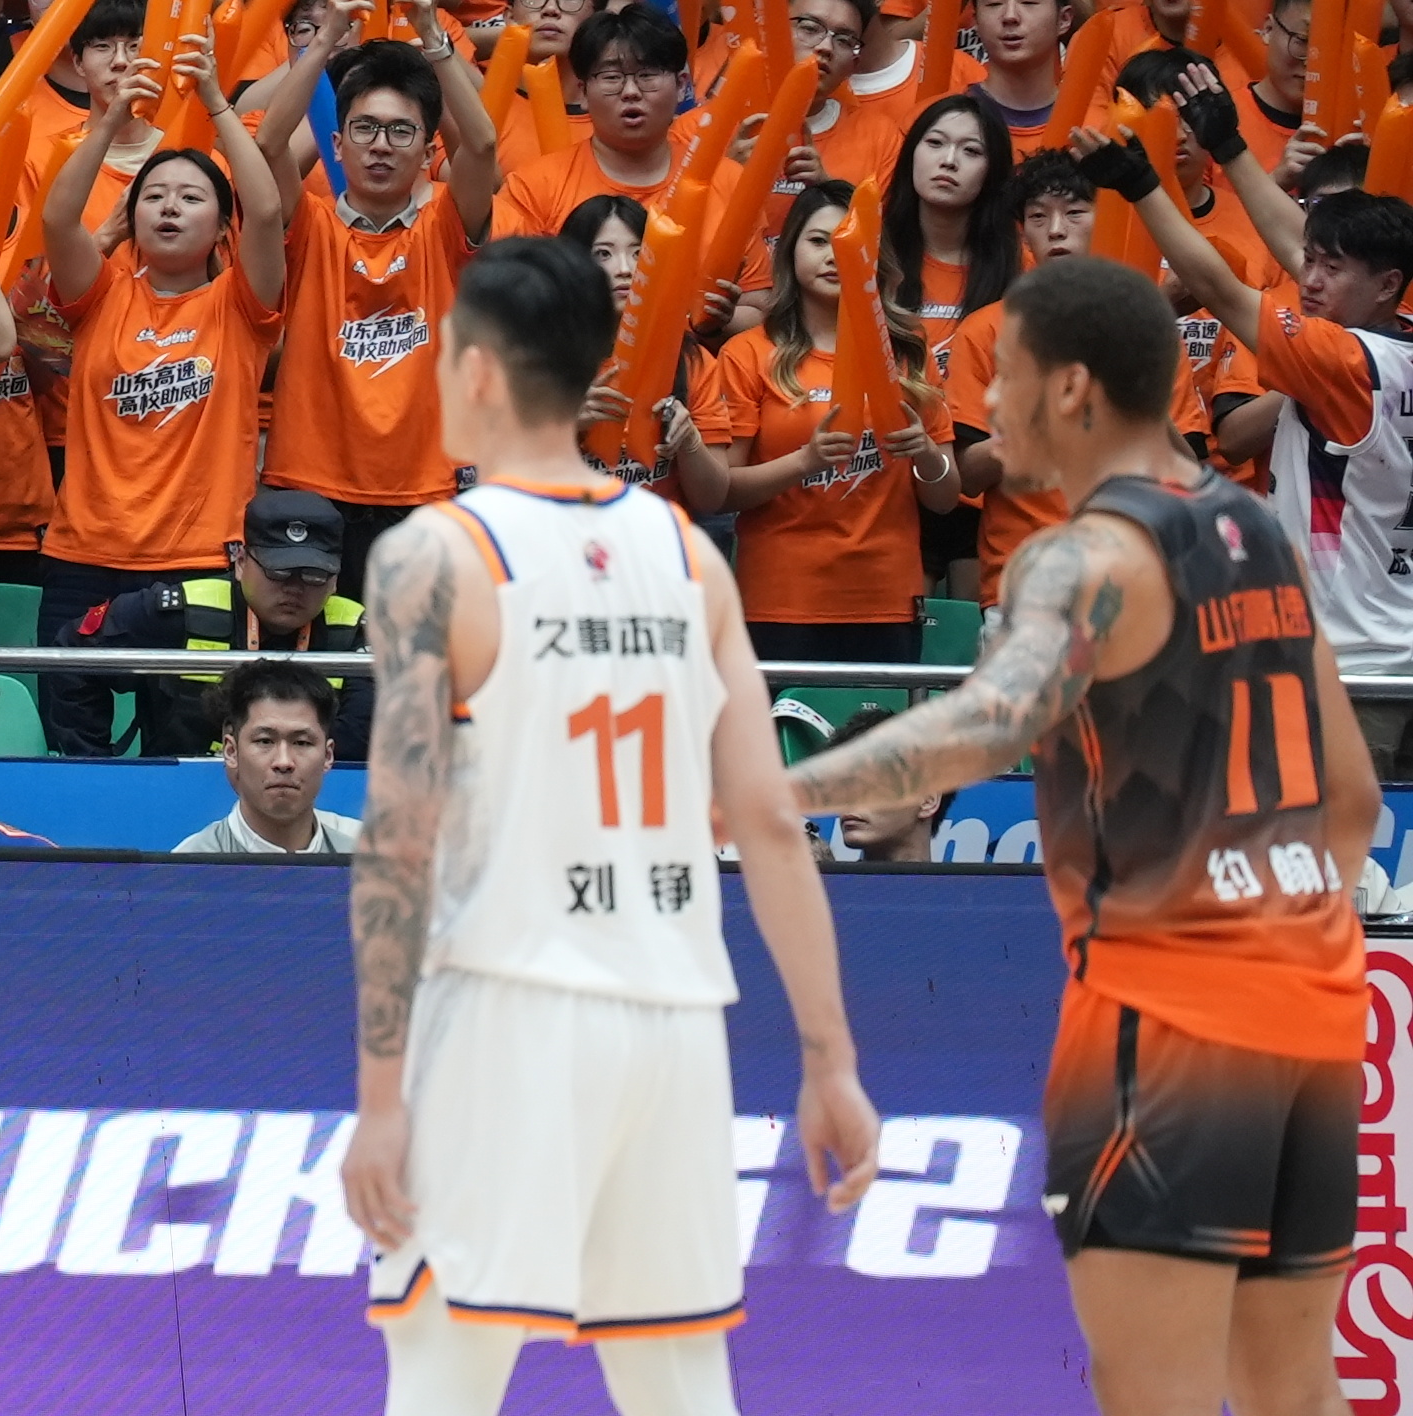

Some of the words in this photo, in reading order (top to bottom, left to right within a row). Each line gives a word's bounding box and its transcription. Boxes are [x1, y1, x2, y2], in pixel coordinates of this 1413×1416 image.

[339, 315, 414, 341] 山东高速
[343, 324, 429, 355] 高校助威团
[112, 357, 196, 394] 山东高速
[118, 371, 214, 415] 高校助威团
[568, 694, 666, 827] 11
[1227, 674, 1319, 814] 11
[567, 862, 694, 914] 刘铮
[845, 1117, 1023, 1278] 2
